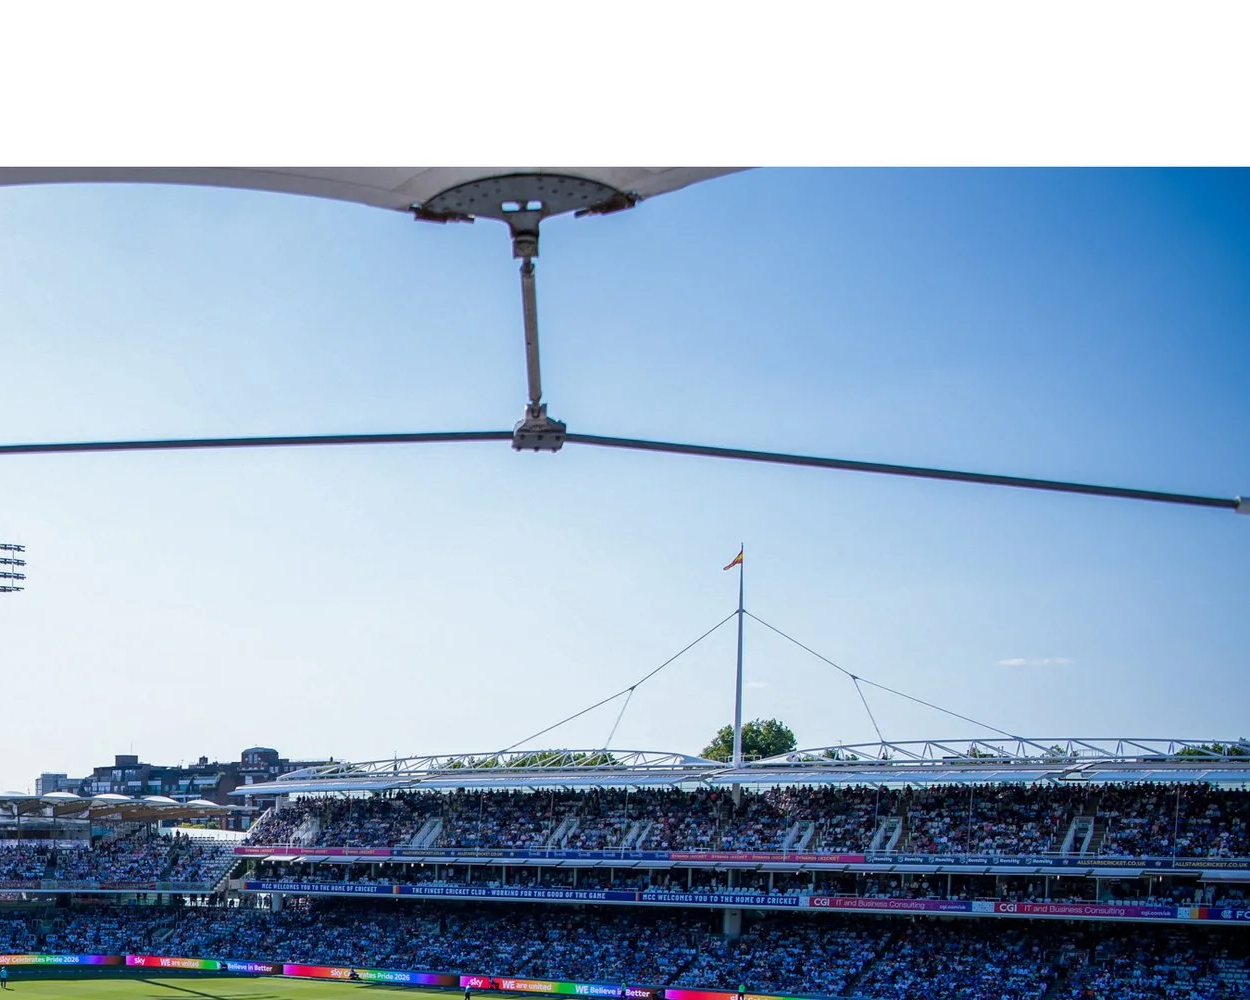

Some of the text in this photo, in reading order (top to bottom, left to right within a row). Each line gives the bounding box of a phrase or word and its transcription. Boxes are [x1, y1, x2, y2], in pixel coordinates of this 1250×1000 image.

[890, 901, 925, 910] Consulting
[1000, 903, 1017, 912] CGI
[1050, 905, 1082, 913] Business
[1085, 906, 1125, 916] Consulting
[134, 957, 145, 966] sky
[160, 958, 170, 966] WE
[181, 960, 199, 968] united
[330, 968, 342, 978] sky
[378, 972, 393, 980] Pride
[394, 972, 410, 981] 2026
[470, 978, 483, 987] sky
[502, 980, 515, 989] WE
[528, 982, 551, 991] united
[575, 985, 589, 994] WE
[625, 989, 650, 997] Better
